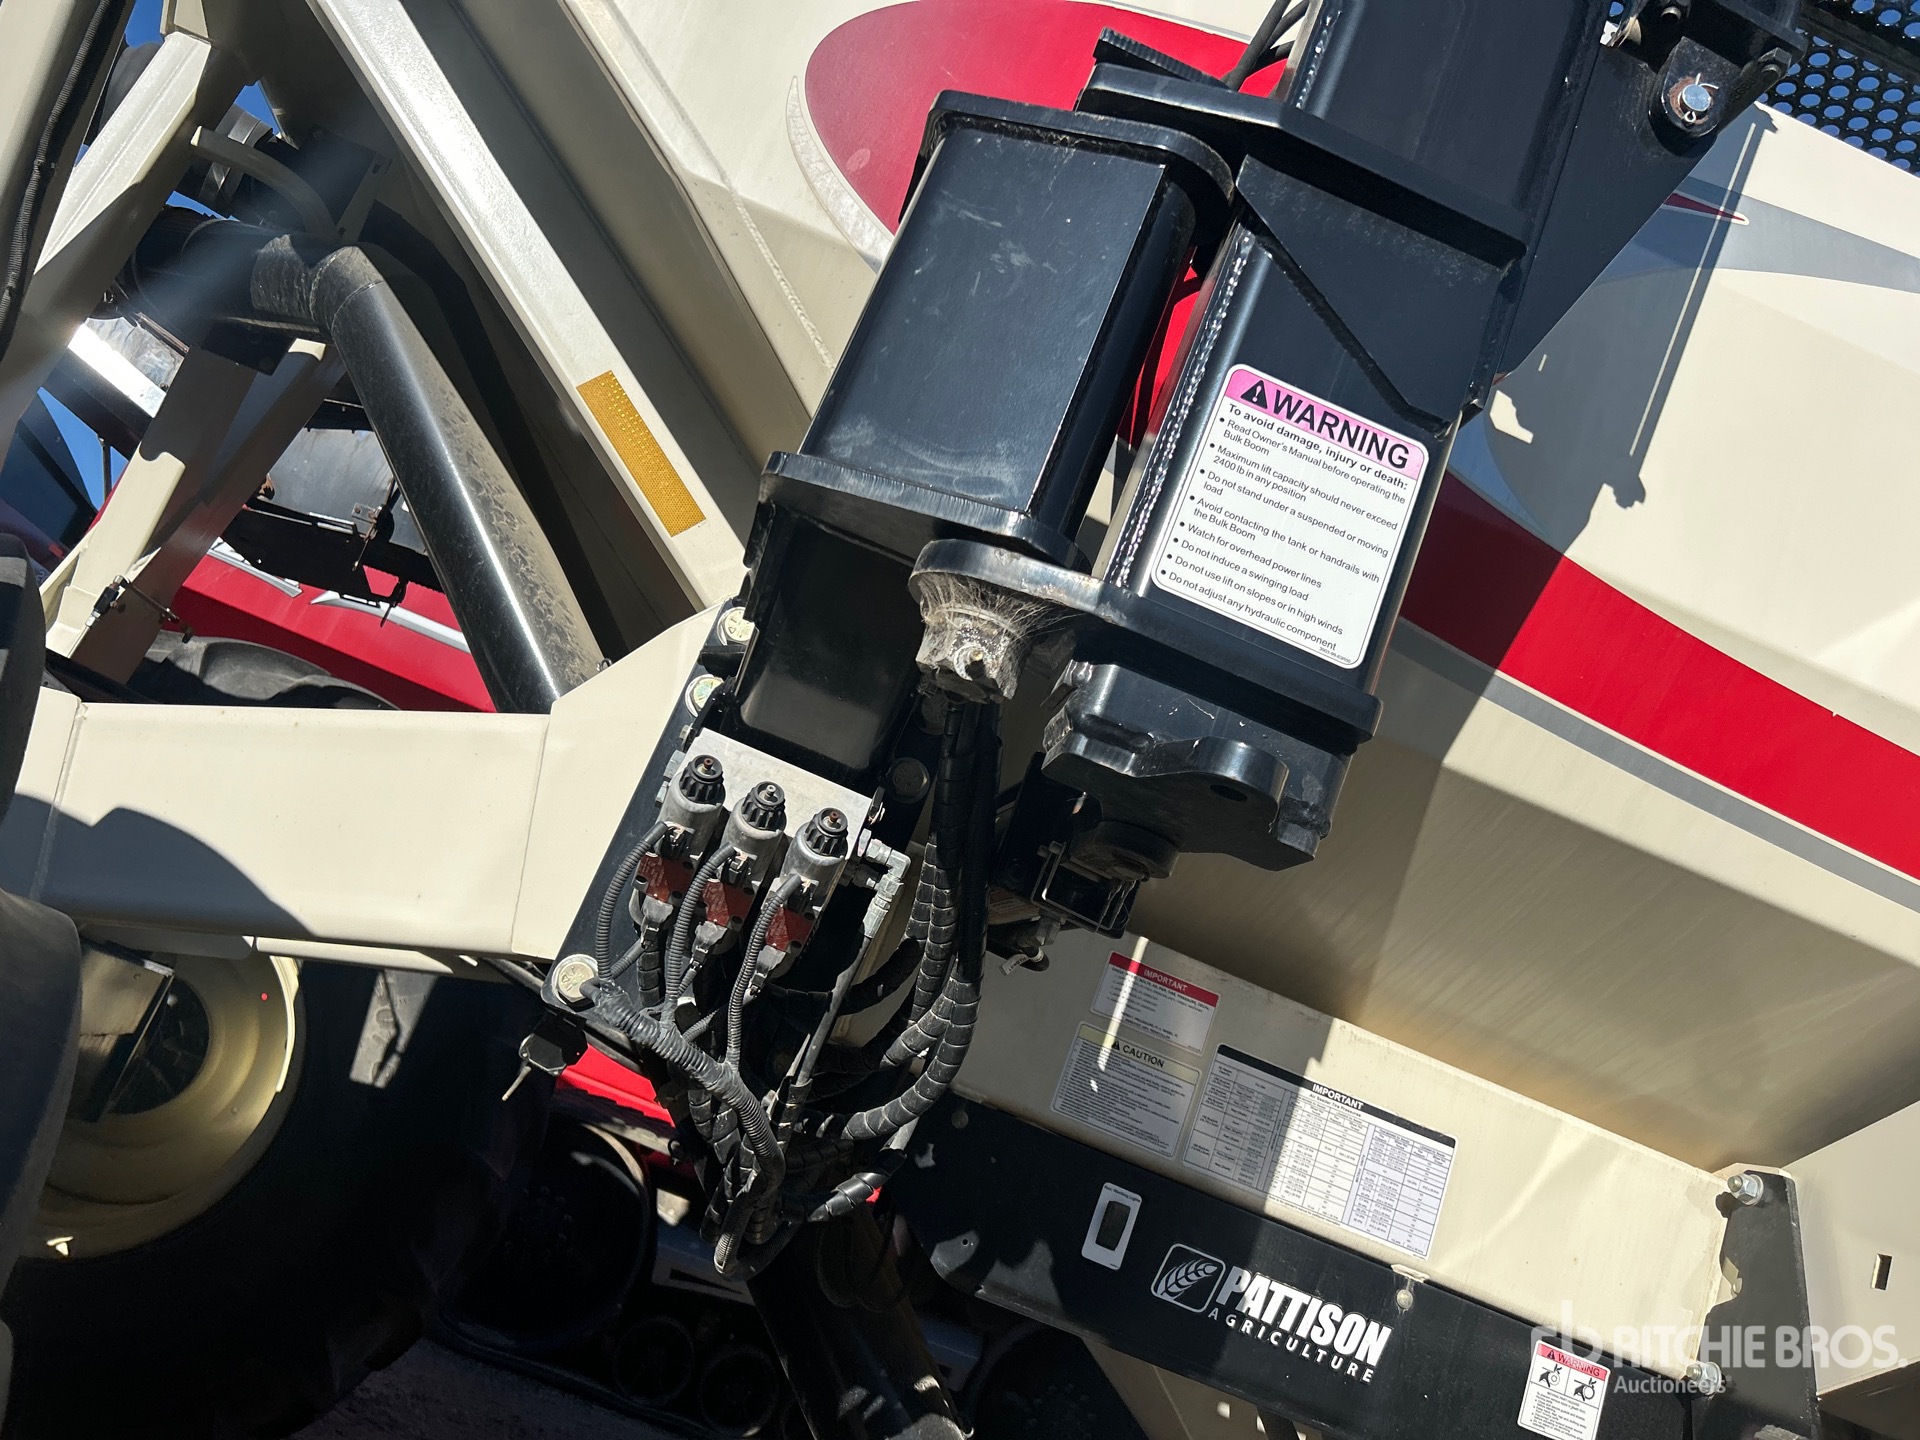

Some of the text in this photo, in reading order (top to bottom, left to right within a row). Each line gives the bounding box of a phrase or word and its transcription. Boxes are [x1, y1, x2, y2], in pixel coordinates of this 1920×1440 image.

[1223, 429, 1270, 456] Bulk Boom
[1227, 419, 1405, 504] Read Owner's Manual before operating the
[1229, 403, 1408, 490] To avoid damage, injury or death:
[1273, 389, 1409, 469] WARNING
[1203, 481, 1224, 496] load
[1213, 455, 1306, 502] 2400 lb in any position
[1217, 445, 1398, 530] Maximum lift capacity should never exceed
[1193, 508, 1256, 541] the Bulk Boom
[1197, 498, 1380, 583] Avoid contacting the tank or handrails with
[1207, 471, 1389, 558] Do not stand under a suspended or moving
[1181, 539, 1309, 601] Do not induce a swinging load
[1188, 523, 1322, 588] Watch for overhead power lines
[1169, 572, 1336, 651] Do not adjust any hydraulic component
[1175, 556, 1343, 635] Do not use lift on slopes or in high winds
[1144, 970, 1187, 992] IMPORTANT
[1123, 1046, 1165, 1068] CAUTION
[1312, 1084, 1364, 1110] IMPORTANT
[1208, 1308, 1373, 1383] AGRICULTURE
[1216, 1266, 1392, 1367] PATTISON
[1558, 1353, 1600, 1376] WARNING
